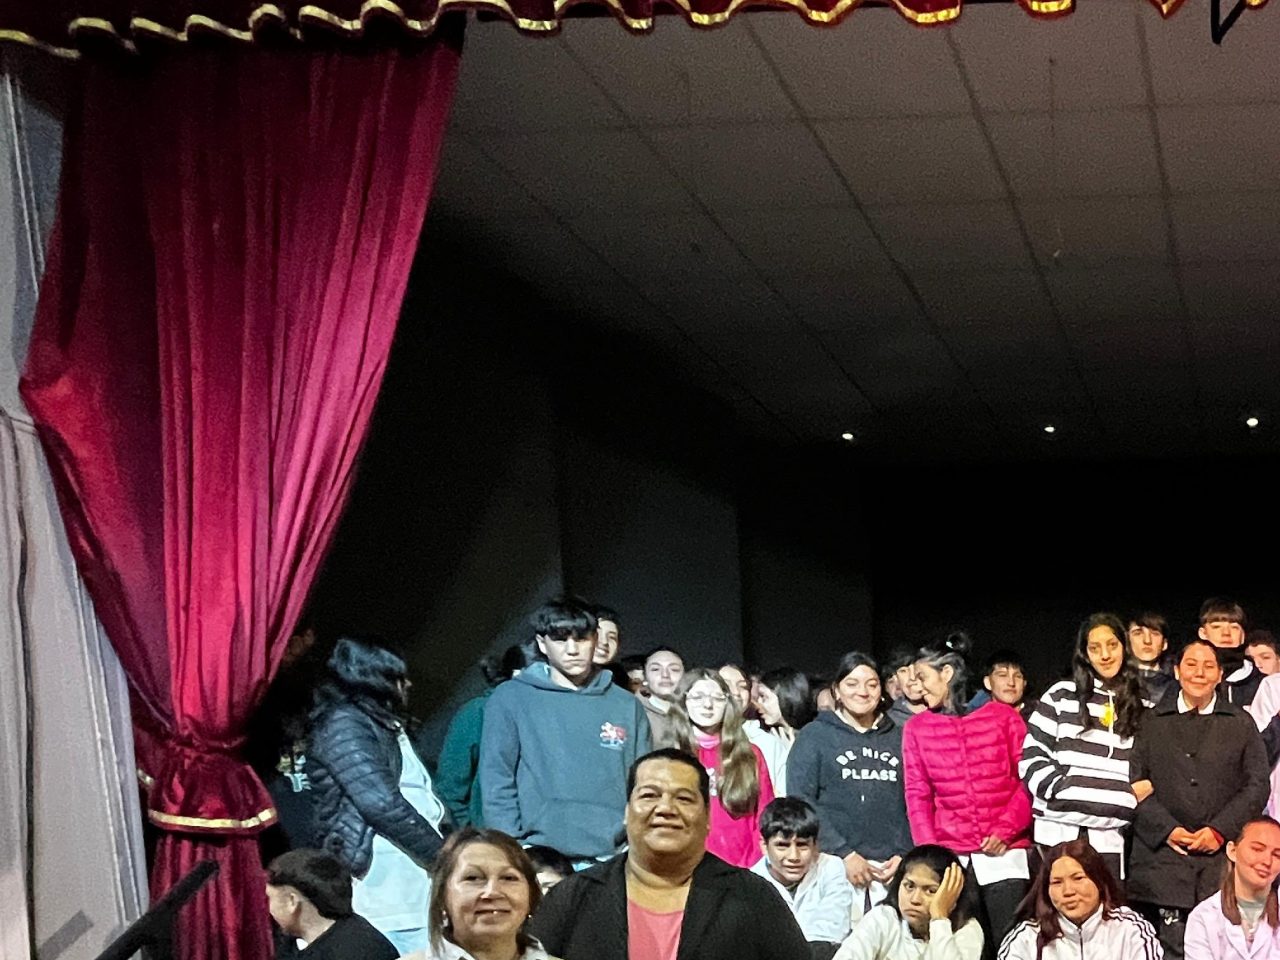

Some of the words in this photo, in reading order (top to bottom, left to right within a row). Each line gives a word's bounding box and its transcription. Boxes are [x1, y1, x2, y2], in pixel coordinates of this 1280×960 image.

[835, 750, 857, 766] BE
[862, 746, 900, 767] NICE
[841, 768, 898, 782] PLEASE
